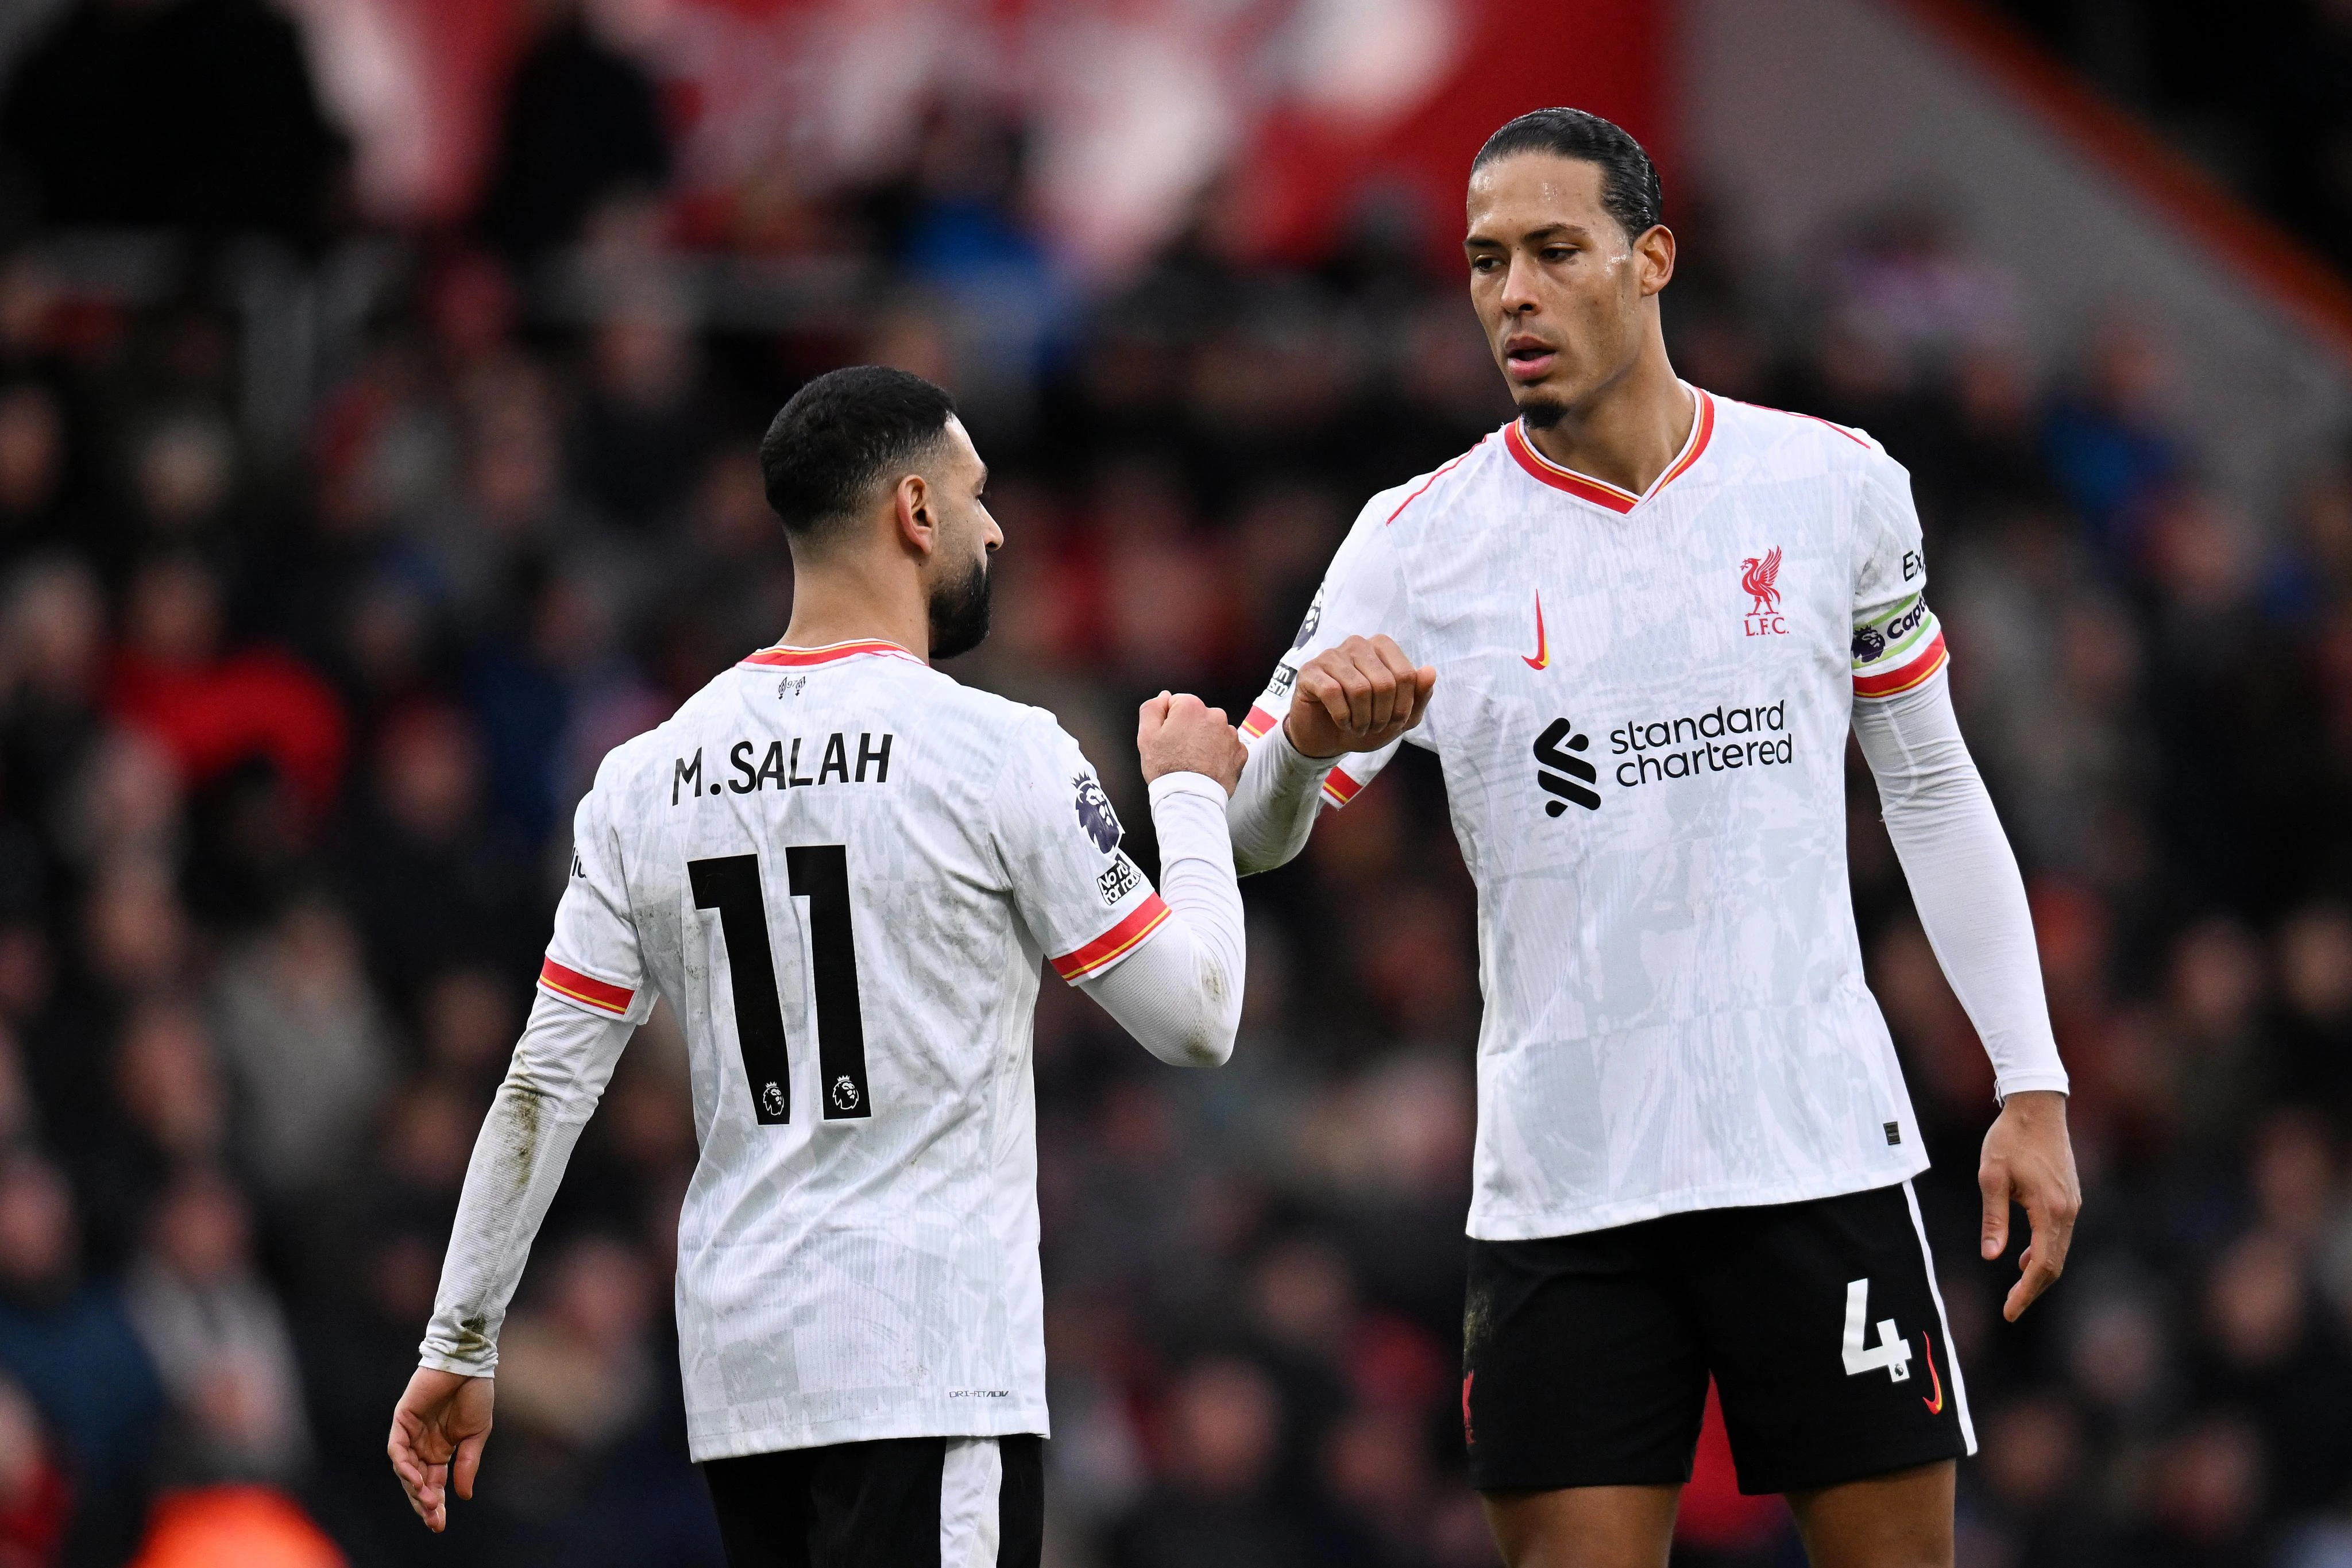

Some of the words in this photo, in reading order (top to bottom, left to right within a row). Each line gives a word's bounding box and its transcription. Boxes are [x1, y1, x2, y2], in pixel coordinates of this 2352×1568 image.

[1903, 550, 1924, 582] Ex
[1744, 617, 1790, 636] L.F.C.
[1887, 595, 1926, 639] Capt
[787, 680, 798, 689] 97
[1610, 699, 1785, 755] standard
[672, 732, 893, 806] M.SALAH
[1616, 732, 1792, 787] chartered
[687, 845, 872, 1125] 11
[1842, 1278, 1912, 1382] 4
